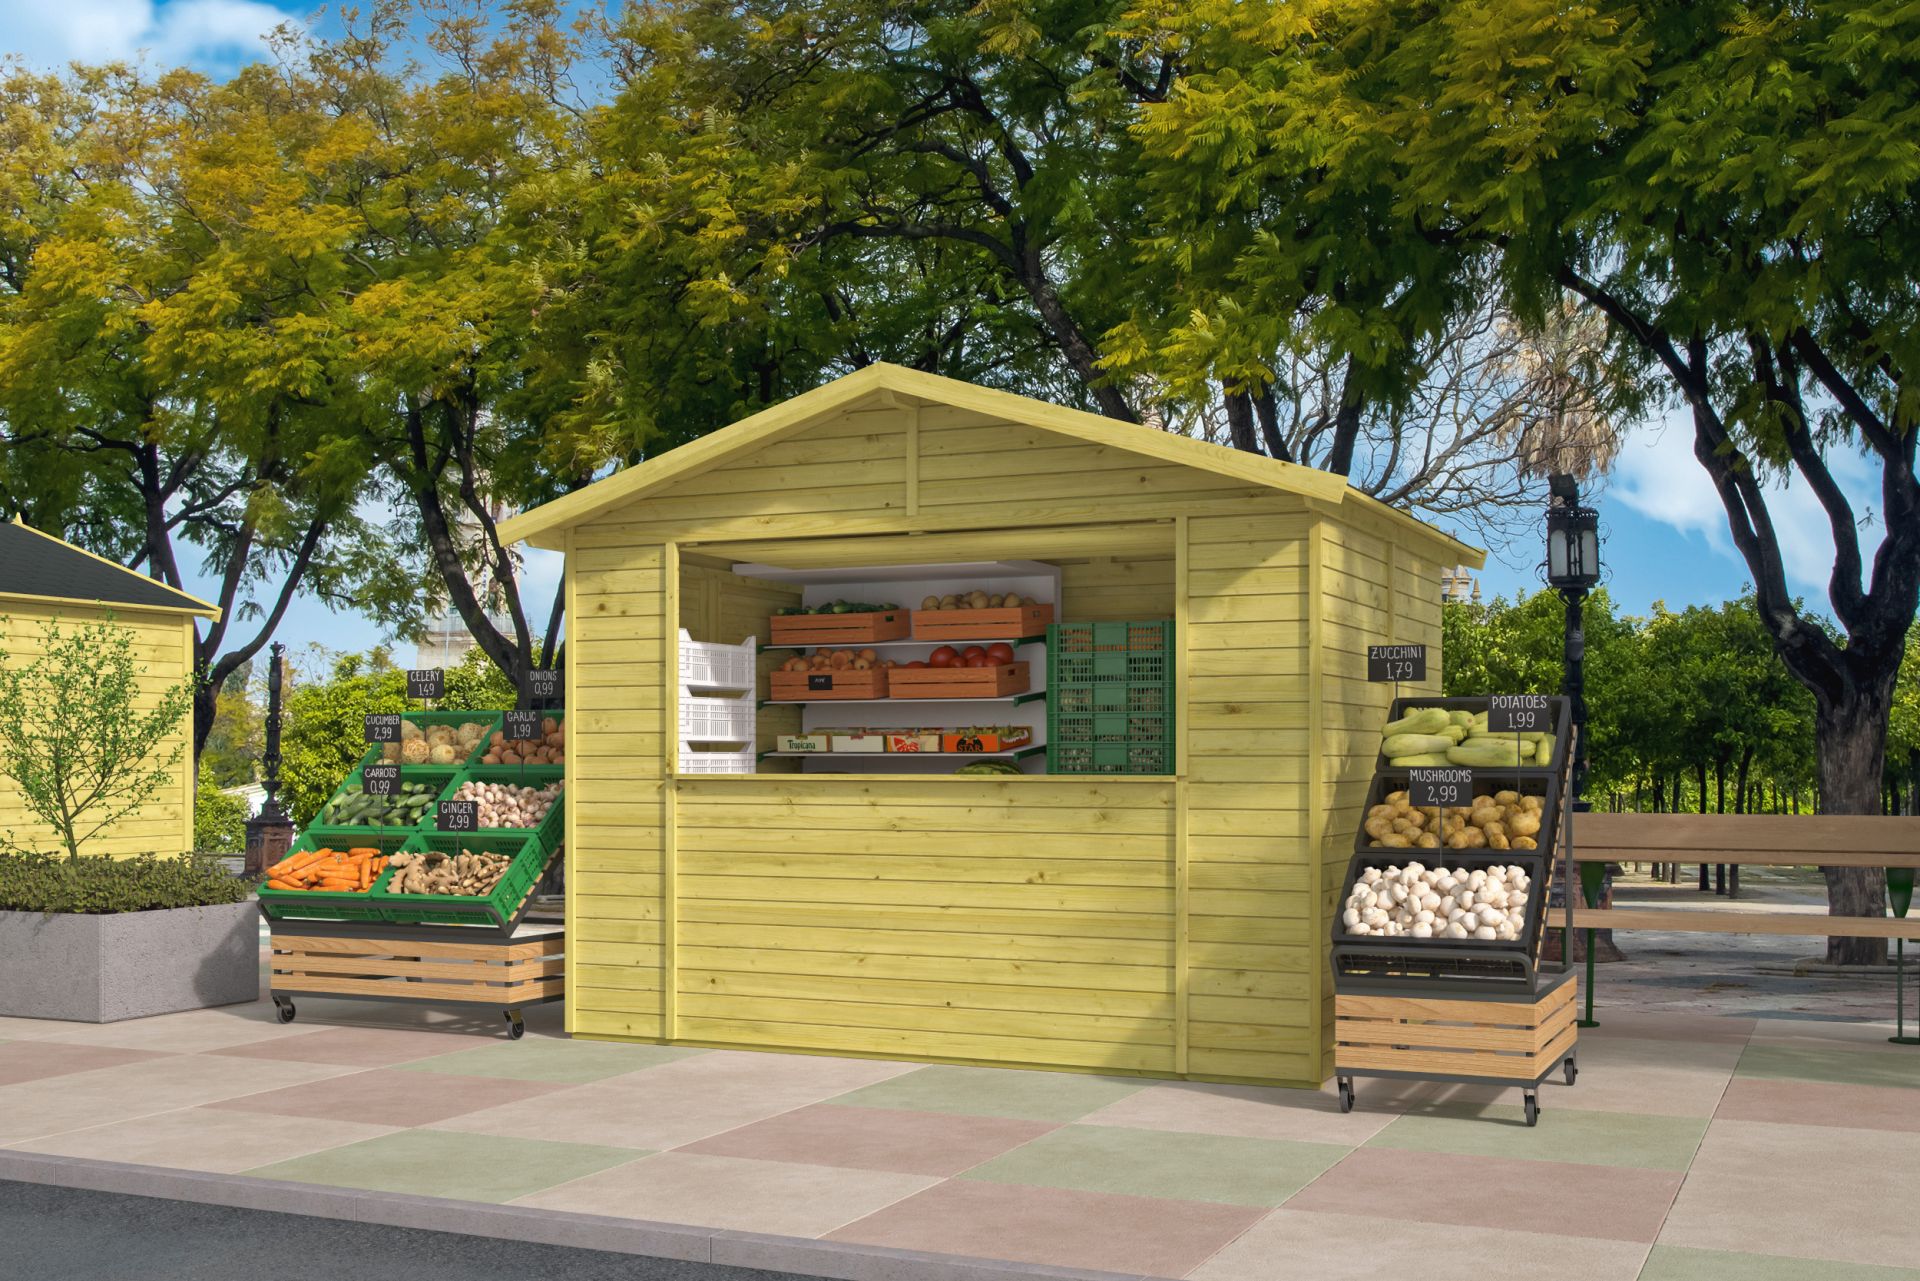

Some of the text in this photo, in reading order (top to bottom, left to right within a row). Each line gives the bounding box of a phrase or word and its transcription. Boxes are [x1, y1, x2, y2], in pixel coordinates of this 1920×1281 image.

[1371, 646, 1422, 660] ZUCCHINI
[410, 671, 440, 682] CELERY
[529, 670, 558, 681] ONIONS
[1386, 662, 1413, 681] 1,79
[534, 682, 553, 695] 0,99
[1492, 695, 1547, 709] POTATOES
[365, 715, 400, 726] CUCUMBER
[506, 711, 536, 722] GARLIC
[1507, 711, 1535, 730] 1,99
[374, 727, 392, 741] 2,99
[513, 724, 531, 739] 1,99
[787, 739, 816, 751] Tropicana
[364, 767, 397, 778] CARROTS
[1409, 769, 1472, 783] MUSHROOMS
[370, 780, 390, 795] 0,99
[1427, 785, 1457, 804] 2,99
[441, 802, 473, 814] GINGER
[448, 815, 469, 830] 2,99
